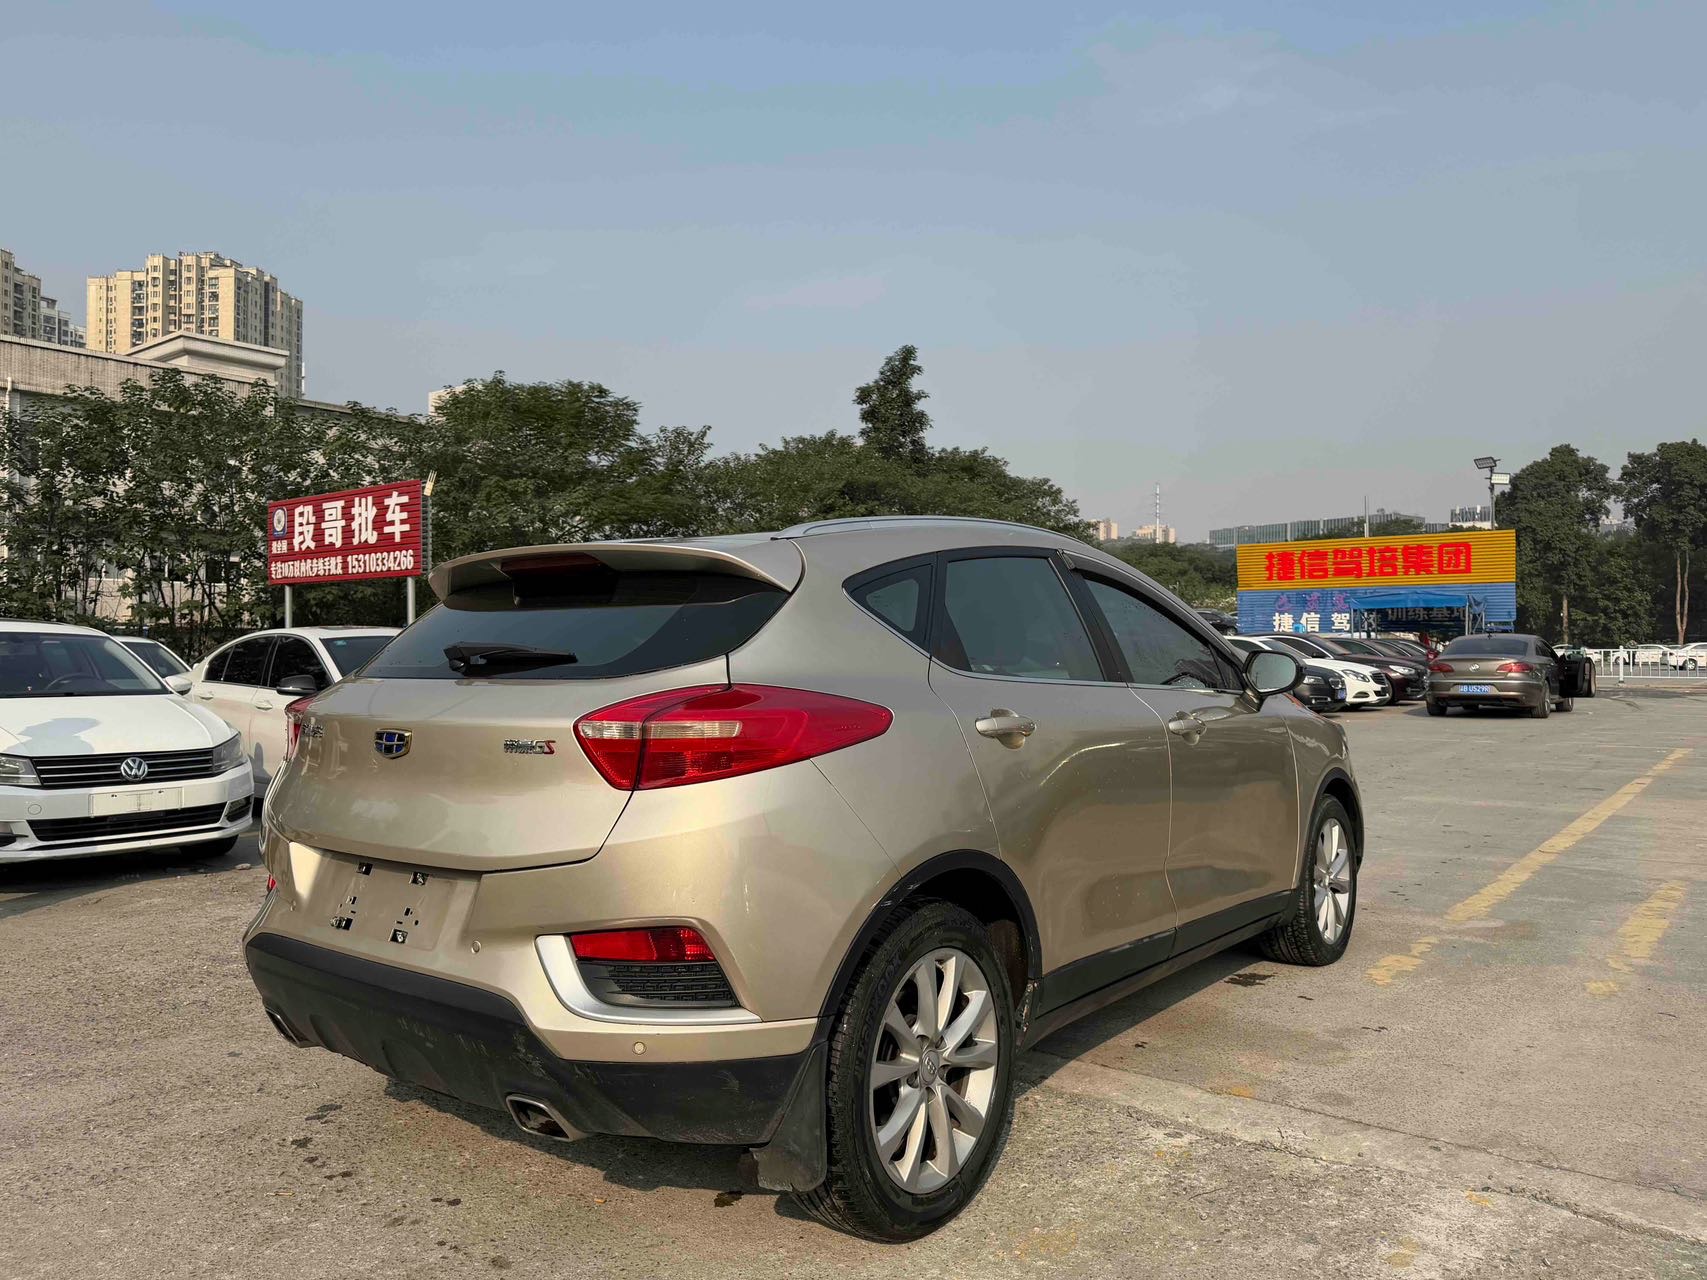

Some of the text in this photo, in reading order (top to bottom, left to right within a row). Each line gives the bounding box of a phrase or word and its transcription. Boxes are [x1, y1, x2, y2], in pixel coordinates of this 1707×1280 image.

[293, 491, 411, 552] 段哥批车
[347, 550, 414, 574] 15310334266
[1265, 542, 1472, 581] 捷信驾培集团
